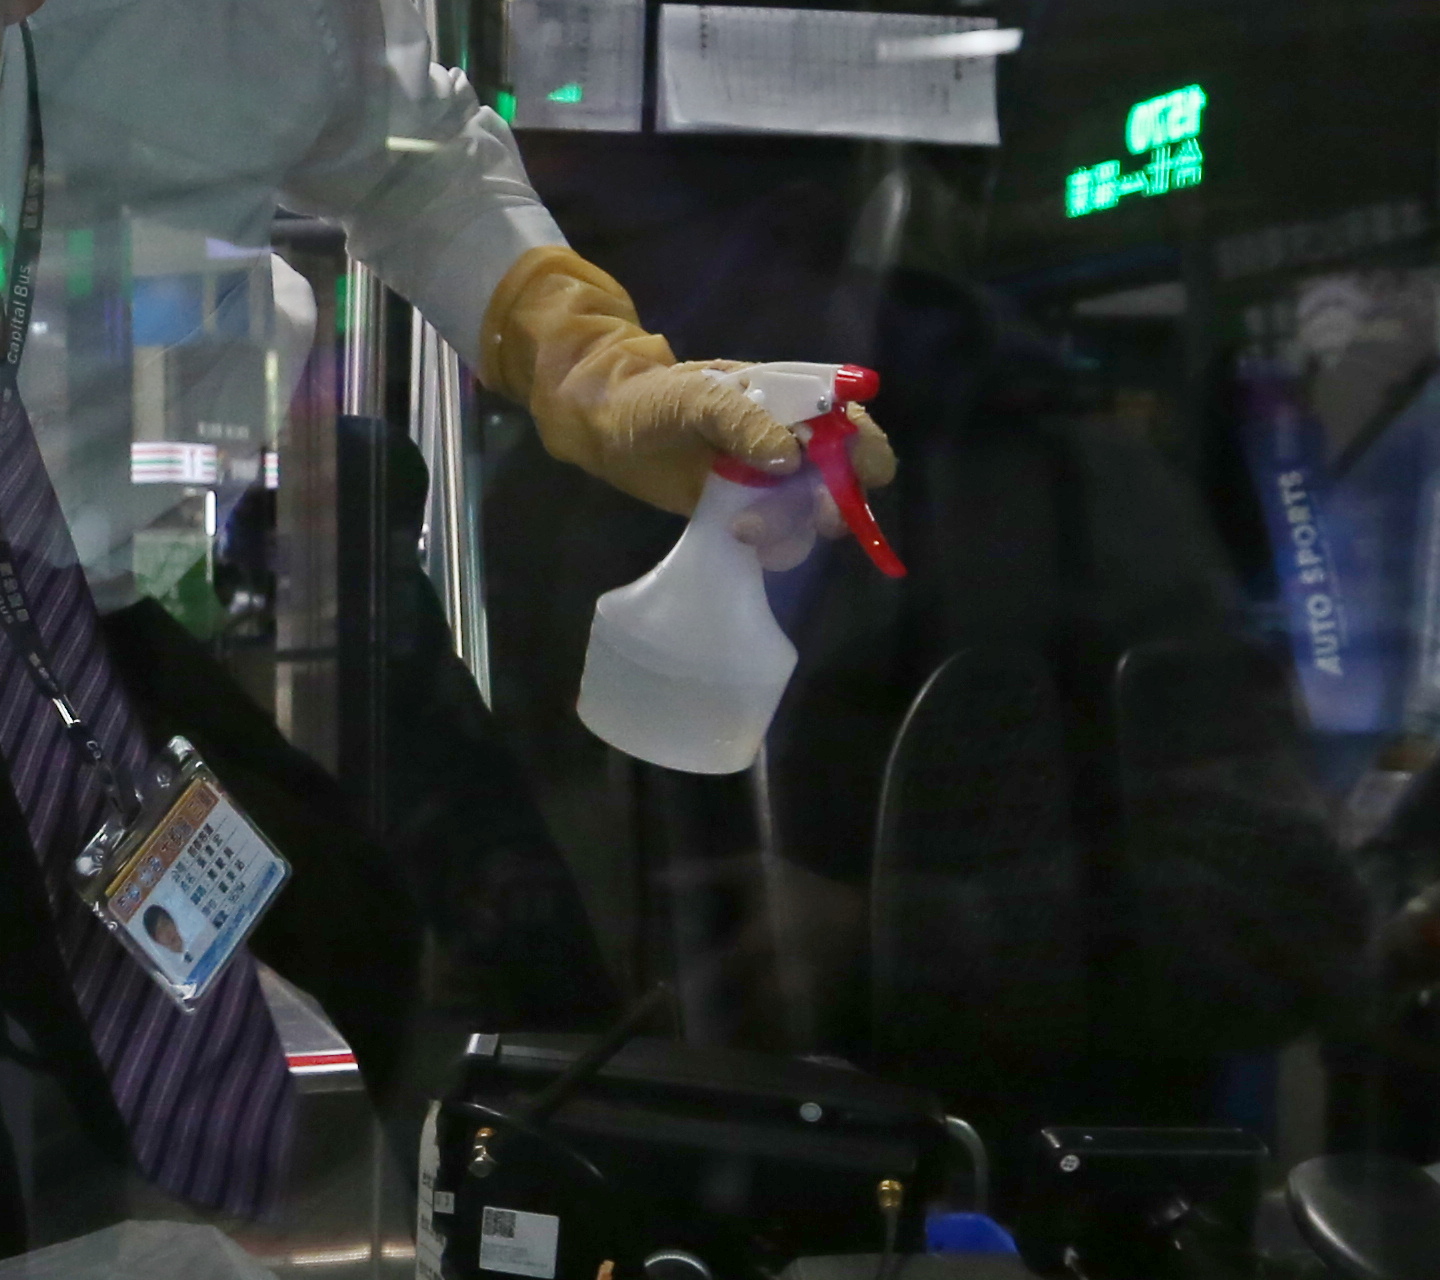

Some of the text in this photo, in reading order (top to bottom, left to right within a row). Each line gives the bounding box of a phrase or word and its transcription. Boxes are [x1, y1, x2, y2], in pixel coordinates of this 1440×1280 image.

[7, 265, 31, 365] Capital Bus
[1279, 470, 1344, 676] AUTO SPORTS
